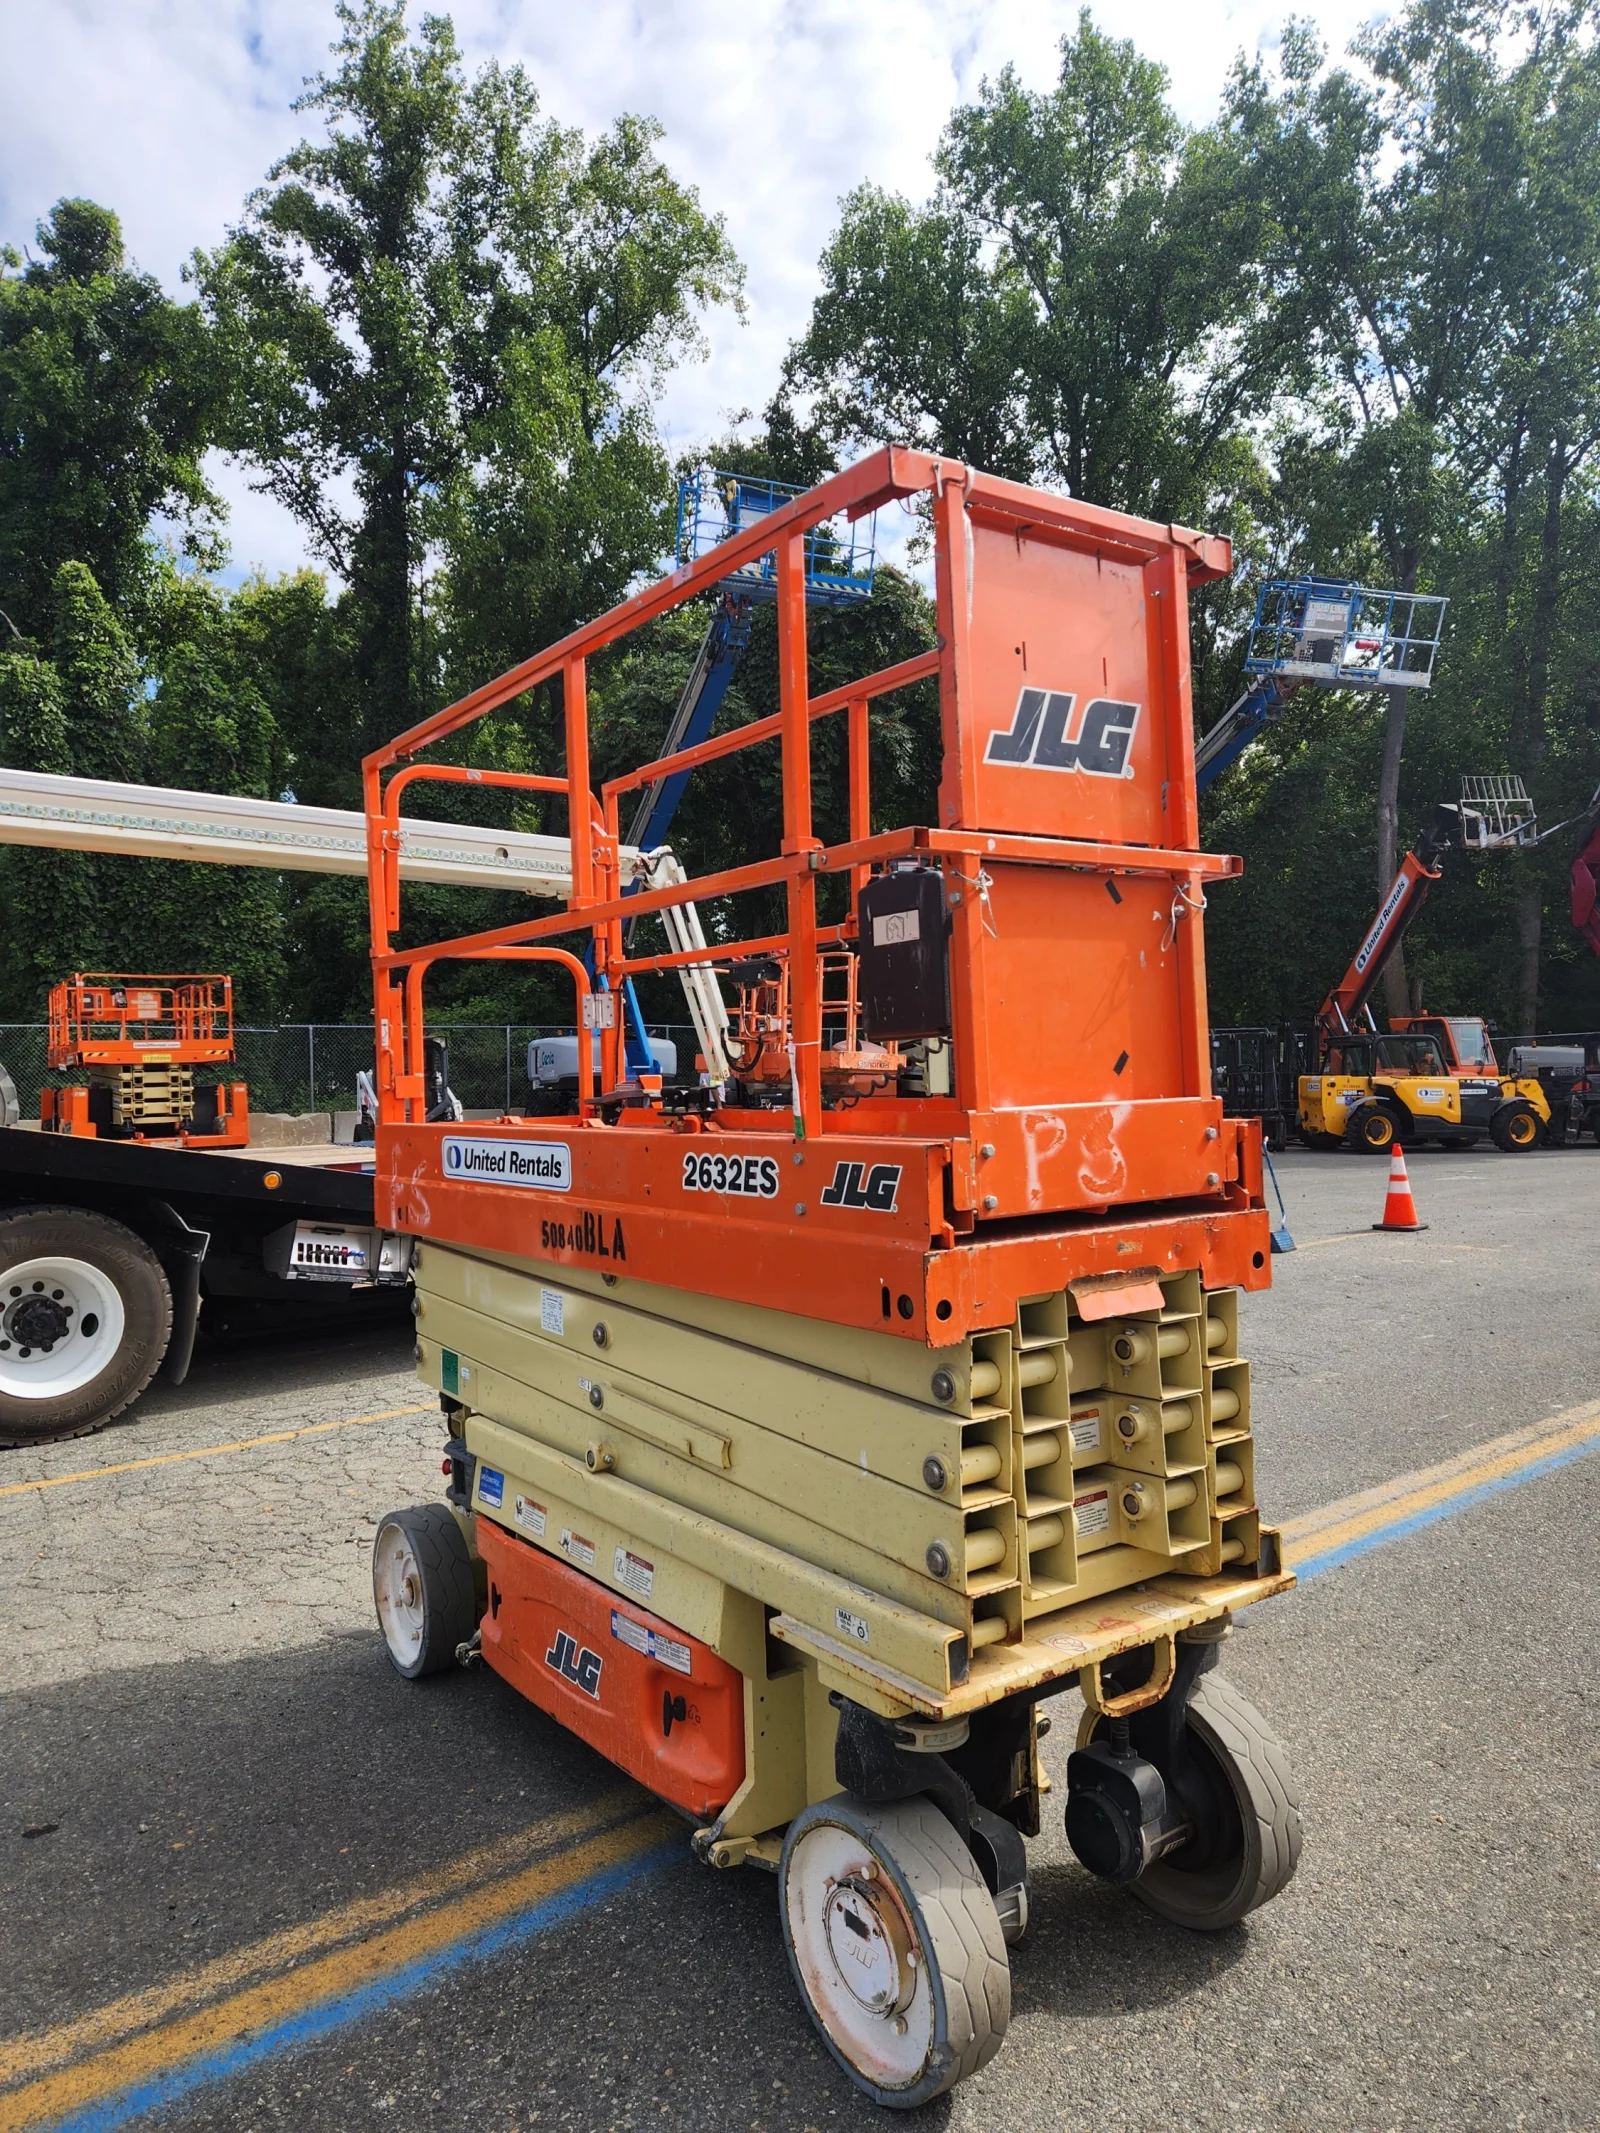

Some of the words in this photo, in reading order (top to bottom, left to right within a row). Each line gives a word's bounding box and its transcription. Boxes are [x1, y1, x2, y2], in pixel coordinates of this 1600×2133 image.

[984, 686, 1141, 779] JLG
[1364, 919, 1384, 955] United
[1383, 880, 1405, 921] Rentals
[464, 1148, 505, 1173] United
[509, 1151, 562, 1179] Rentals
[683, 1153, 778, 1197] 2632ES
[821, 1161, 903, 1212] JLG
[838, 1609, 852, 1623] MAX
[545, 1629, 603, 1699] JLG
